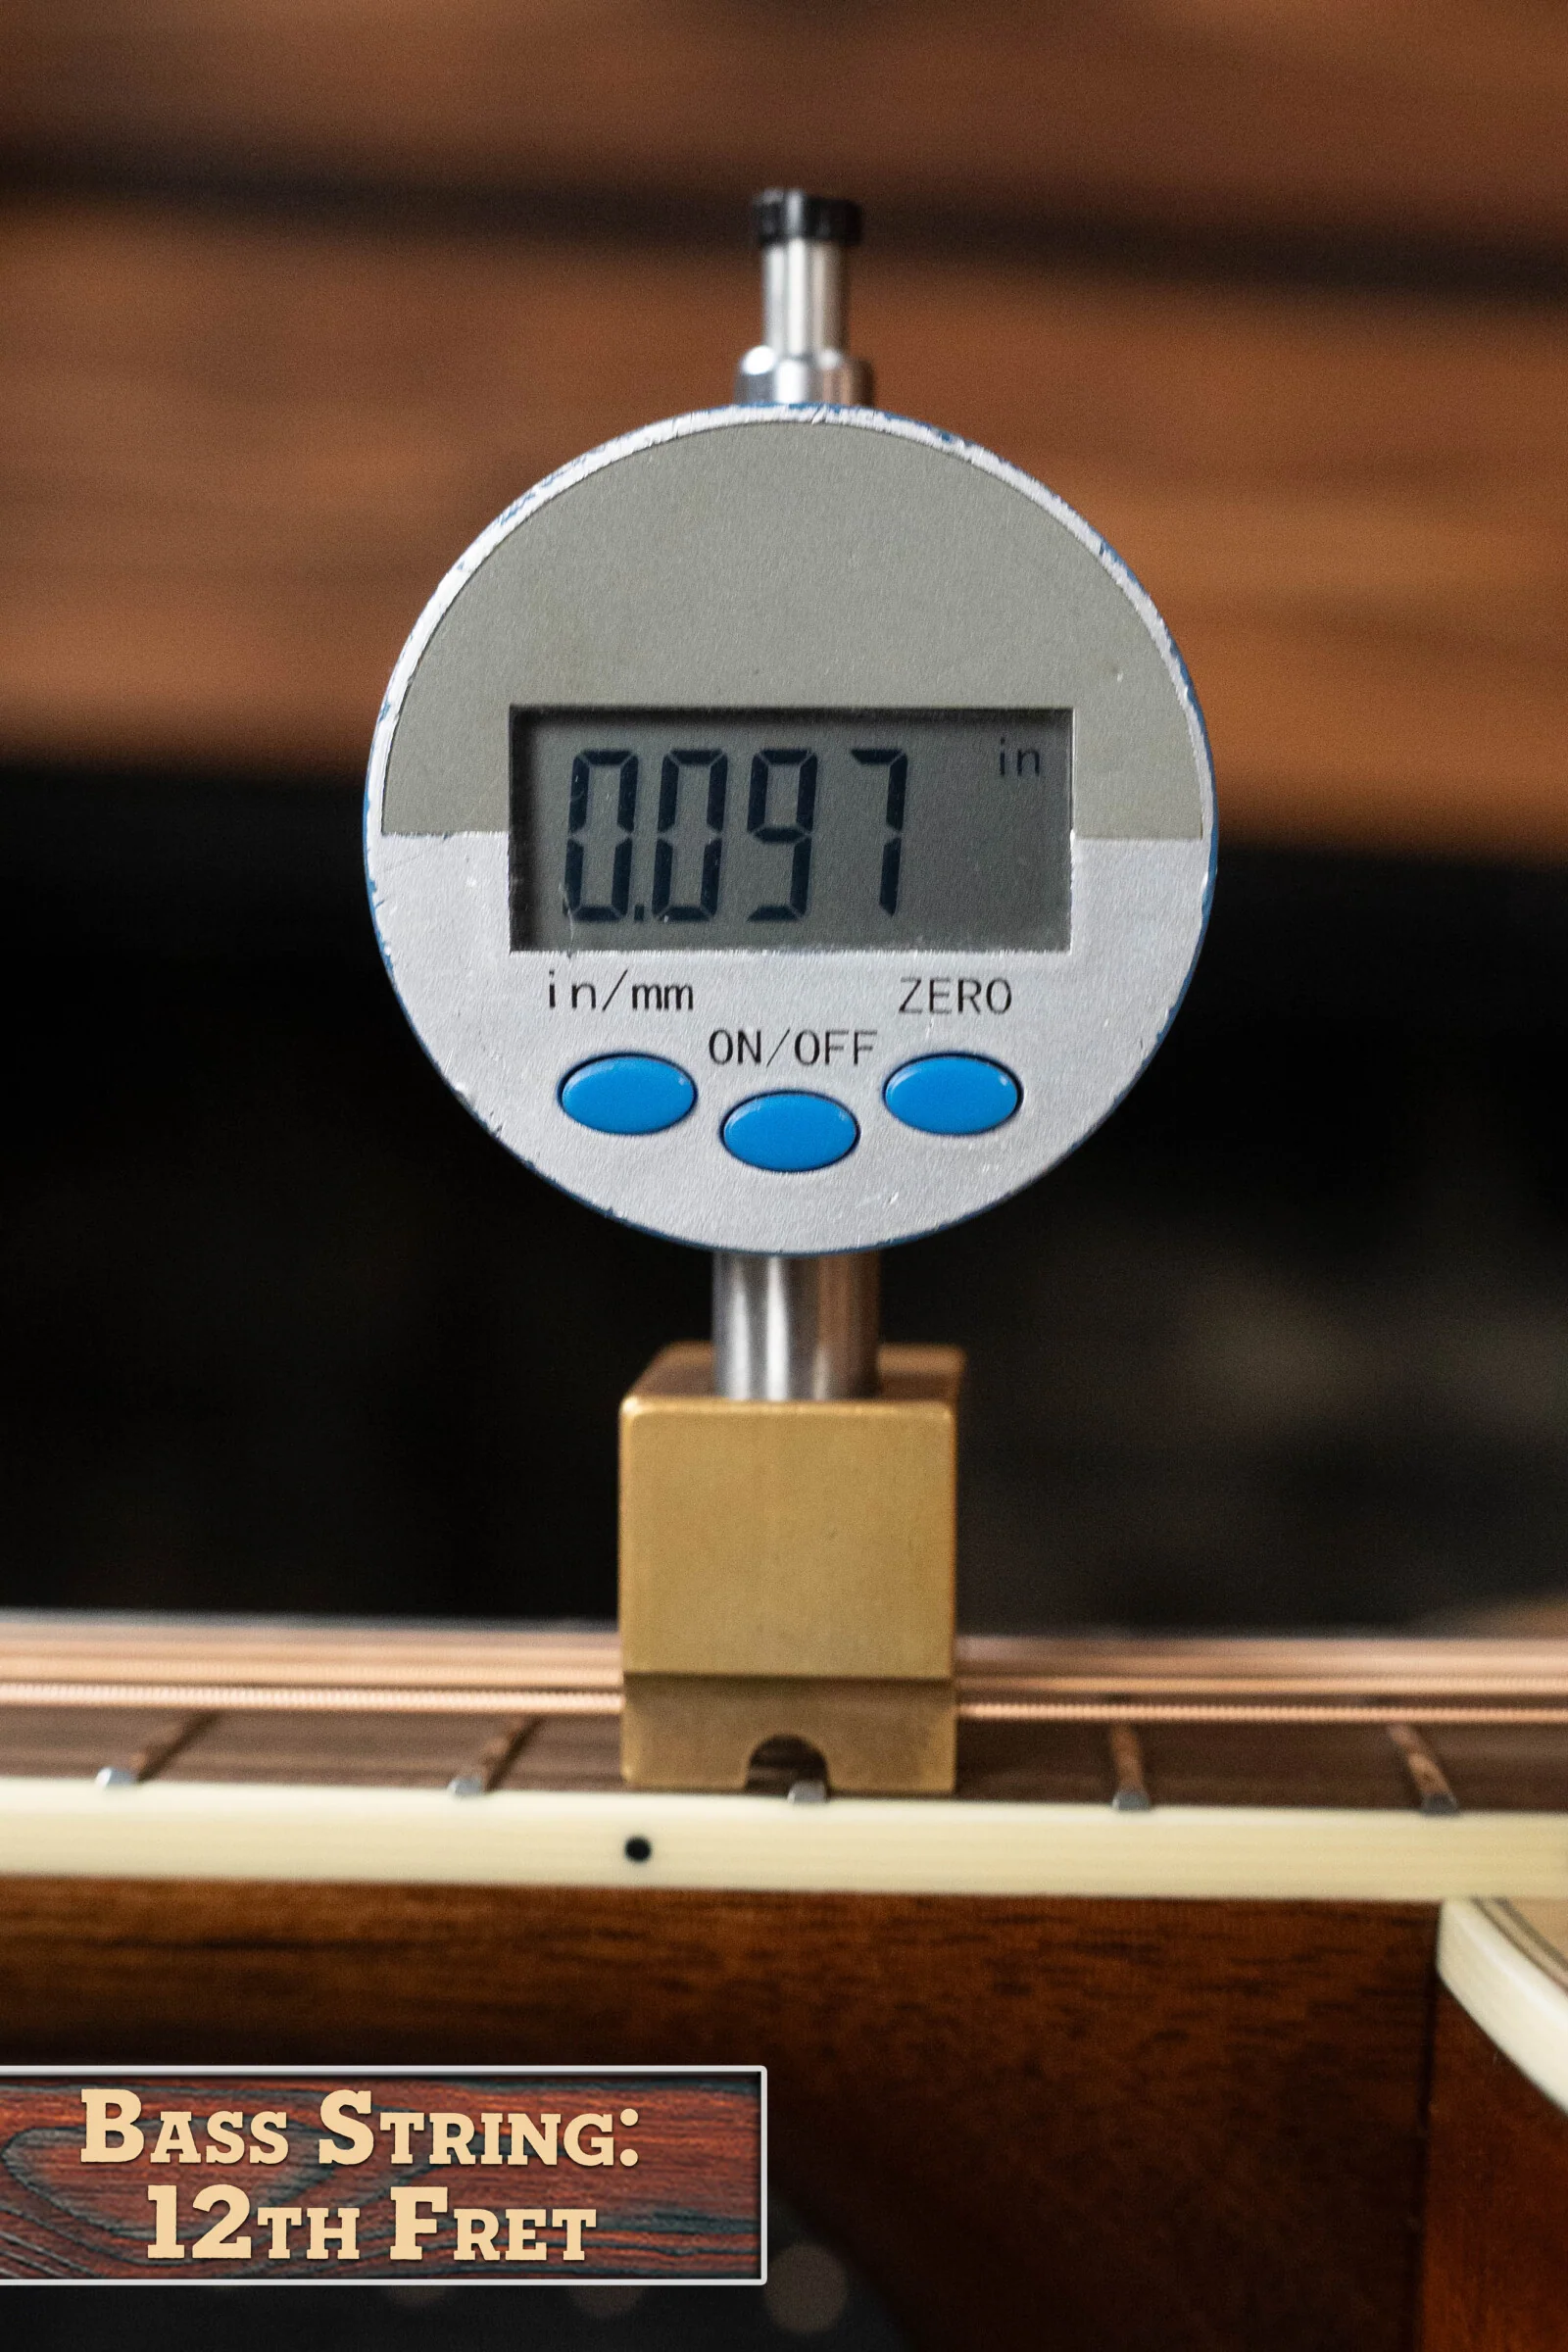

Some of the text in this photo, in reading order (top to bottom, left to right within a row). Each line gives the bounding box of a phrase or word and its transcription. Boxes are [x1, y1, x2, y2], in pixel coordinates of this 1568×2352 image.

[998, 737, 1042, 777] in
[564, 748, 908, 922] 0.097
[548, 969, 694, 1011] in/mm
[899, 977, 1013, 1014] ZERO
[709, 1029, 878, 1066] ON/OFF
